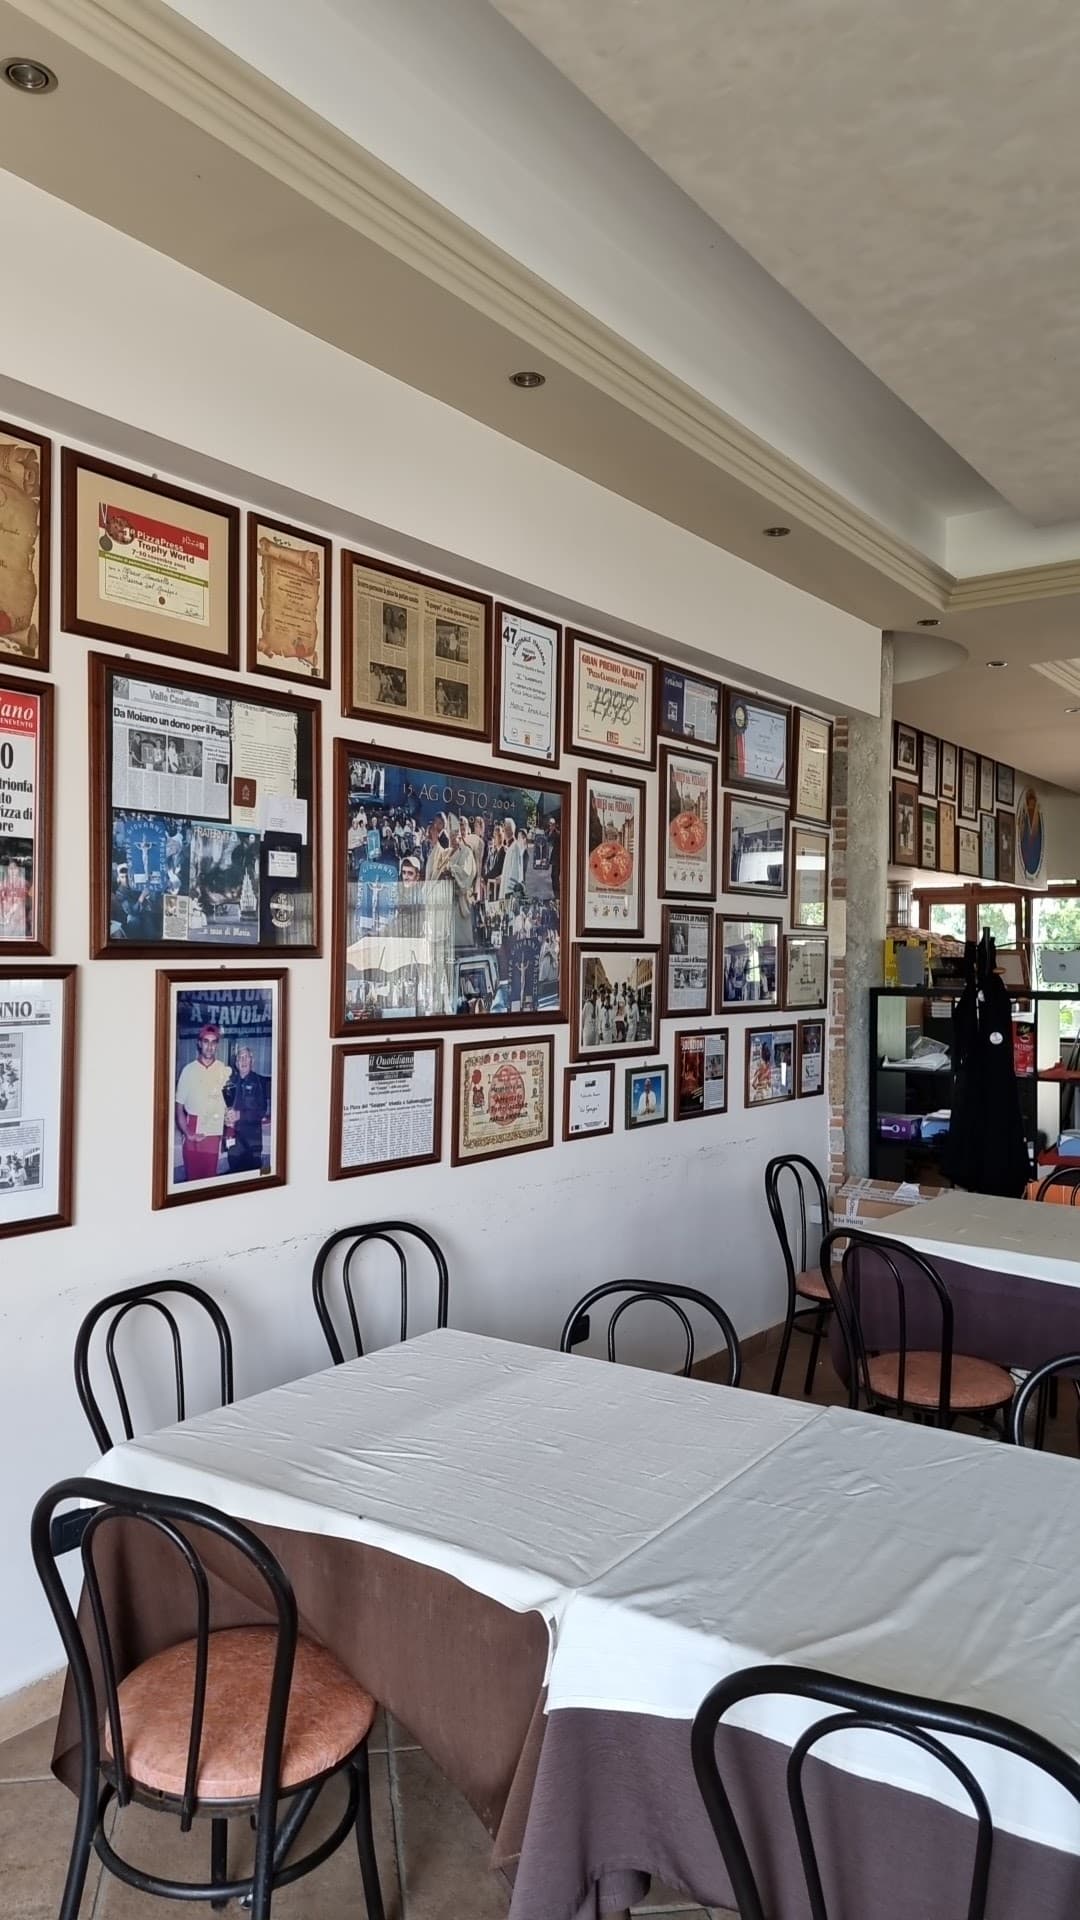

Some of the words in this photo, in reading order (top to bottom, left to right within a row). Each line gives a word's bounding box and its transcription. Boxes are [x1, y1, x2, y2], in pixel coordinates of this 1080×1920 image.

[136, 530, 184, 552] PizzaPress
[138, 540, 168, 558] Trophy
[169, 550, 195, 564] World
[503, 626, 517, 644] 47
[581, 654, 598, 667] GRAN
[599, 659, 620, 674] PREMIO
[149, 689, 168, 702] Valle
[169, 695, 200, 708] Caudina
[113, 707, 126, 718] Da
[126, 709, 158, 724] Moiano
[159, 717, 170, 726] un
[170, 718, 191, 730] dono
[191, 724, 205, 733] per
[205, 724, 210, 733] il
[211, 726, 230, 738] Papa
[419, 783, 488, 809] AGOSTO
[492, 798, 517, 812] 2004
[0, 804, 21, 820] izza
[22, 807, 33, 821] di
[190, 1003, 203, 1022] A
[207, 1003, 272, 1025] TAVOLA
[376, 1054, 414, 1068] Quotidiano
